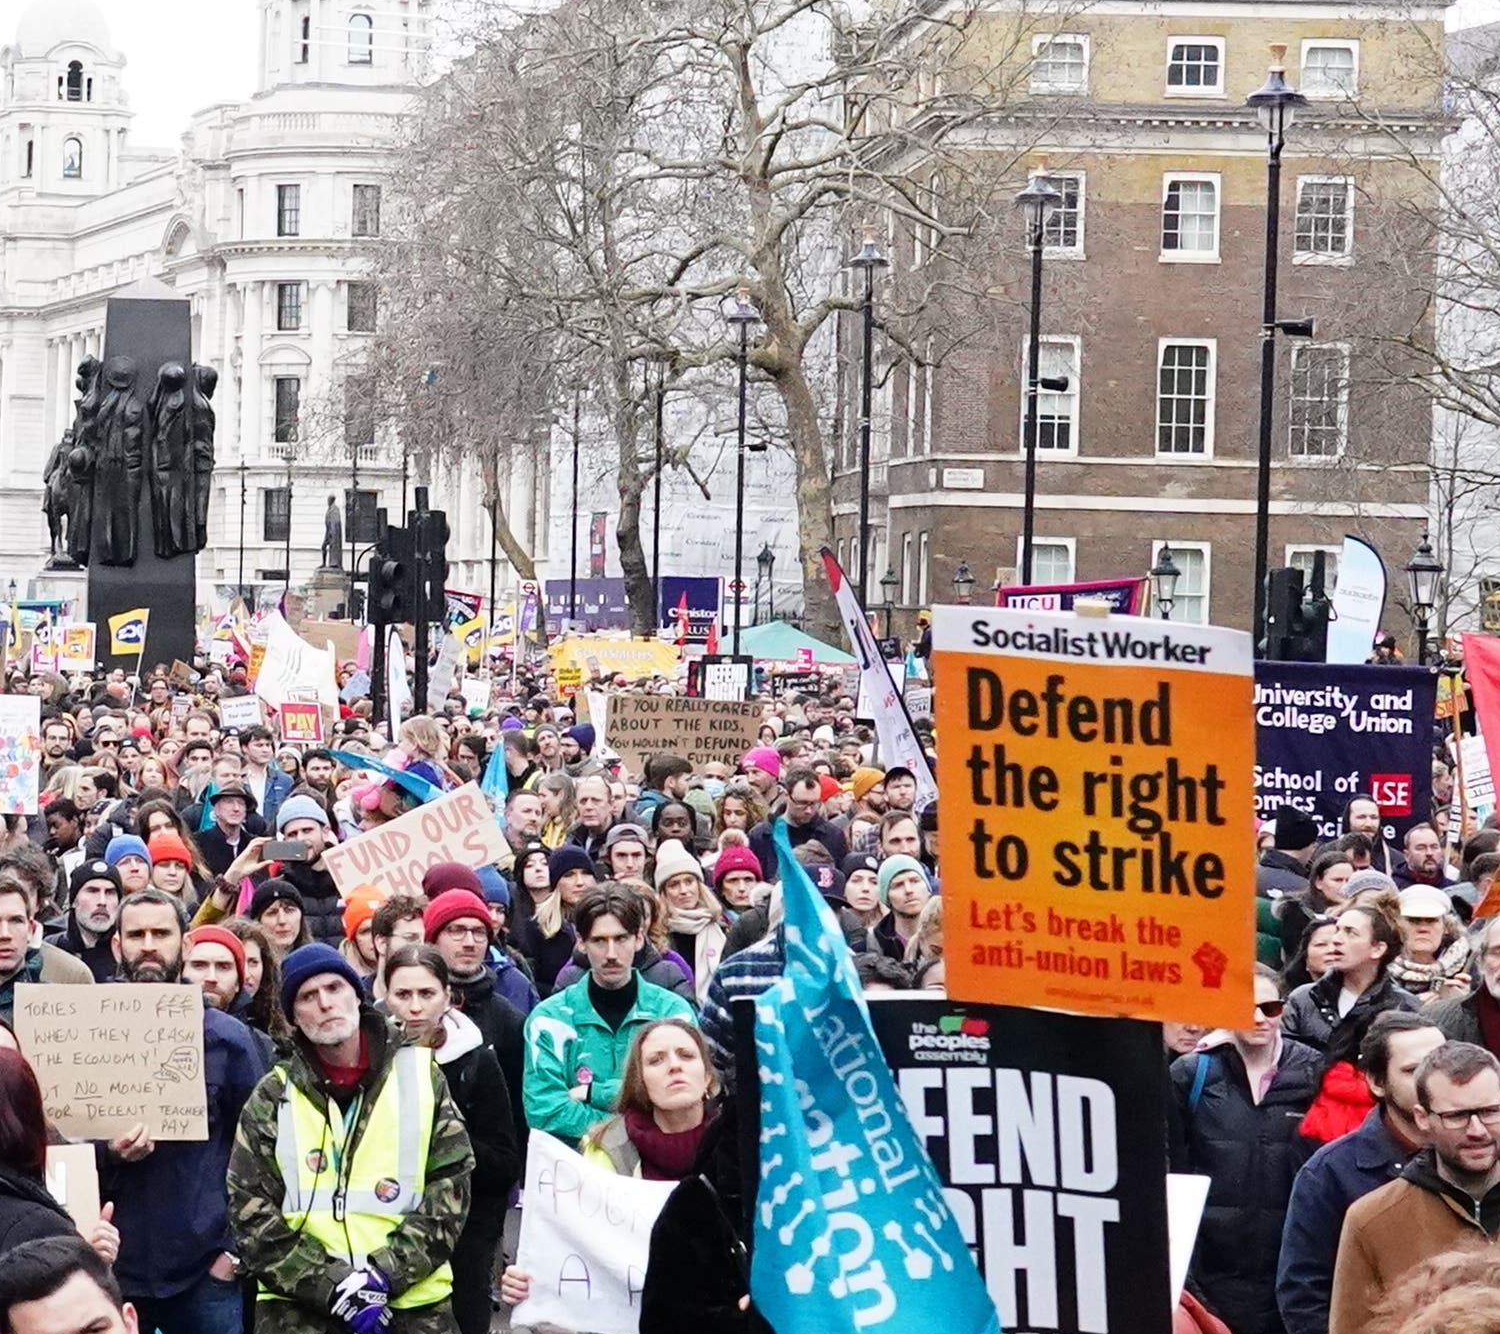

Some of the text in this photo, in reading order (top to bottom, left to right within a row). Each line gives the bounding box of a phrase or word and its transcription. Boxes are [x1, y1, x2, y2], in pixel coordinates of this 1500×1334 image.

[972, 620, 1211, 664] Socialist Worker
[612, 698, 629, 714] IF
[634, 698, 661, 712] YOU
[713, 701, 761, 717] CARED
[966, 668, 1171, 746] Defend
[610, 718, 661, 731] ABOUT
[673, 718, 701, 731] THE
[1257, 708, 1412, 733] College Union
[966, 744, 1225, 835] the right
[1372, 781, 1409, 806] LSE
[327, 795, 484, 886] FUND OUR
[969, 820, 1225, 899] to strike
[969, 900, 1181, 947] Let's break the
[972, 941, 1181, 984] anti-union laws
[24, 1000, 142, 1016] TORIES FIND
[34, 1028, 194, 1044] WHEN THEY CRASH
[913, 1022, 937, 1035] the
[909, 1034, 990, 1051] peoples
[33, 1053, 62, 1066] THE
[914, 1050, 988, 1064] assembly
